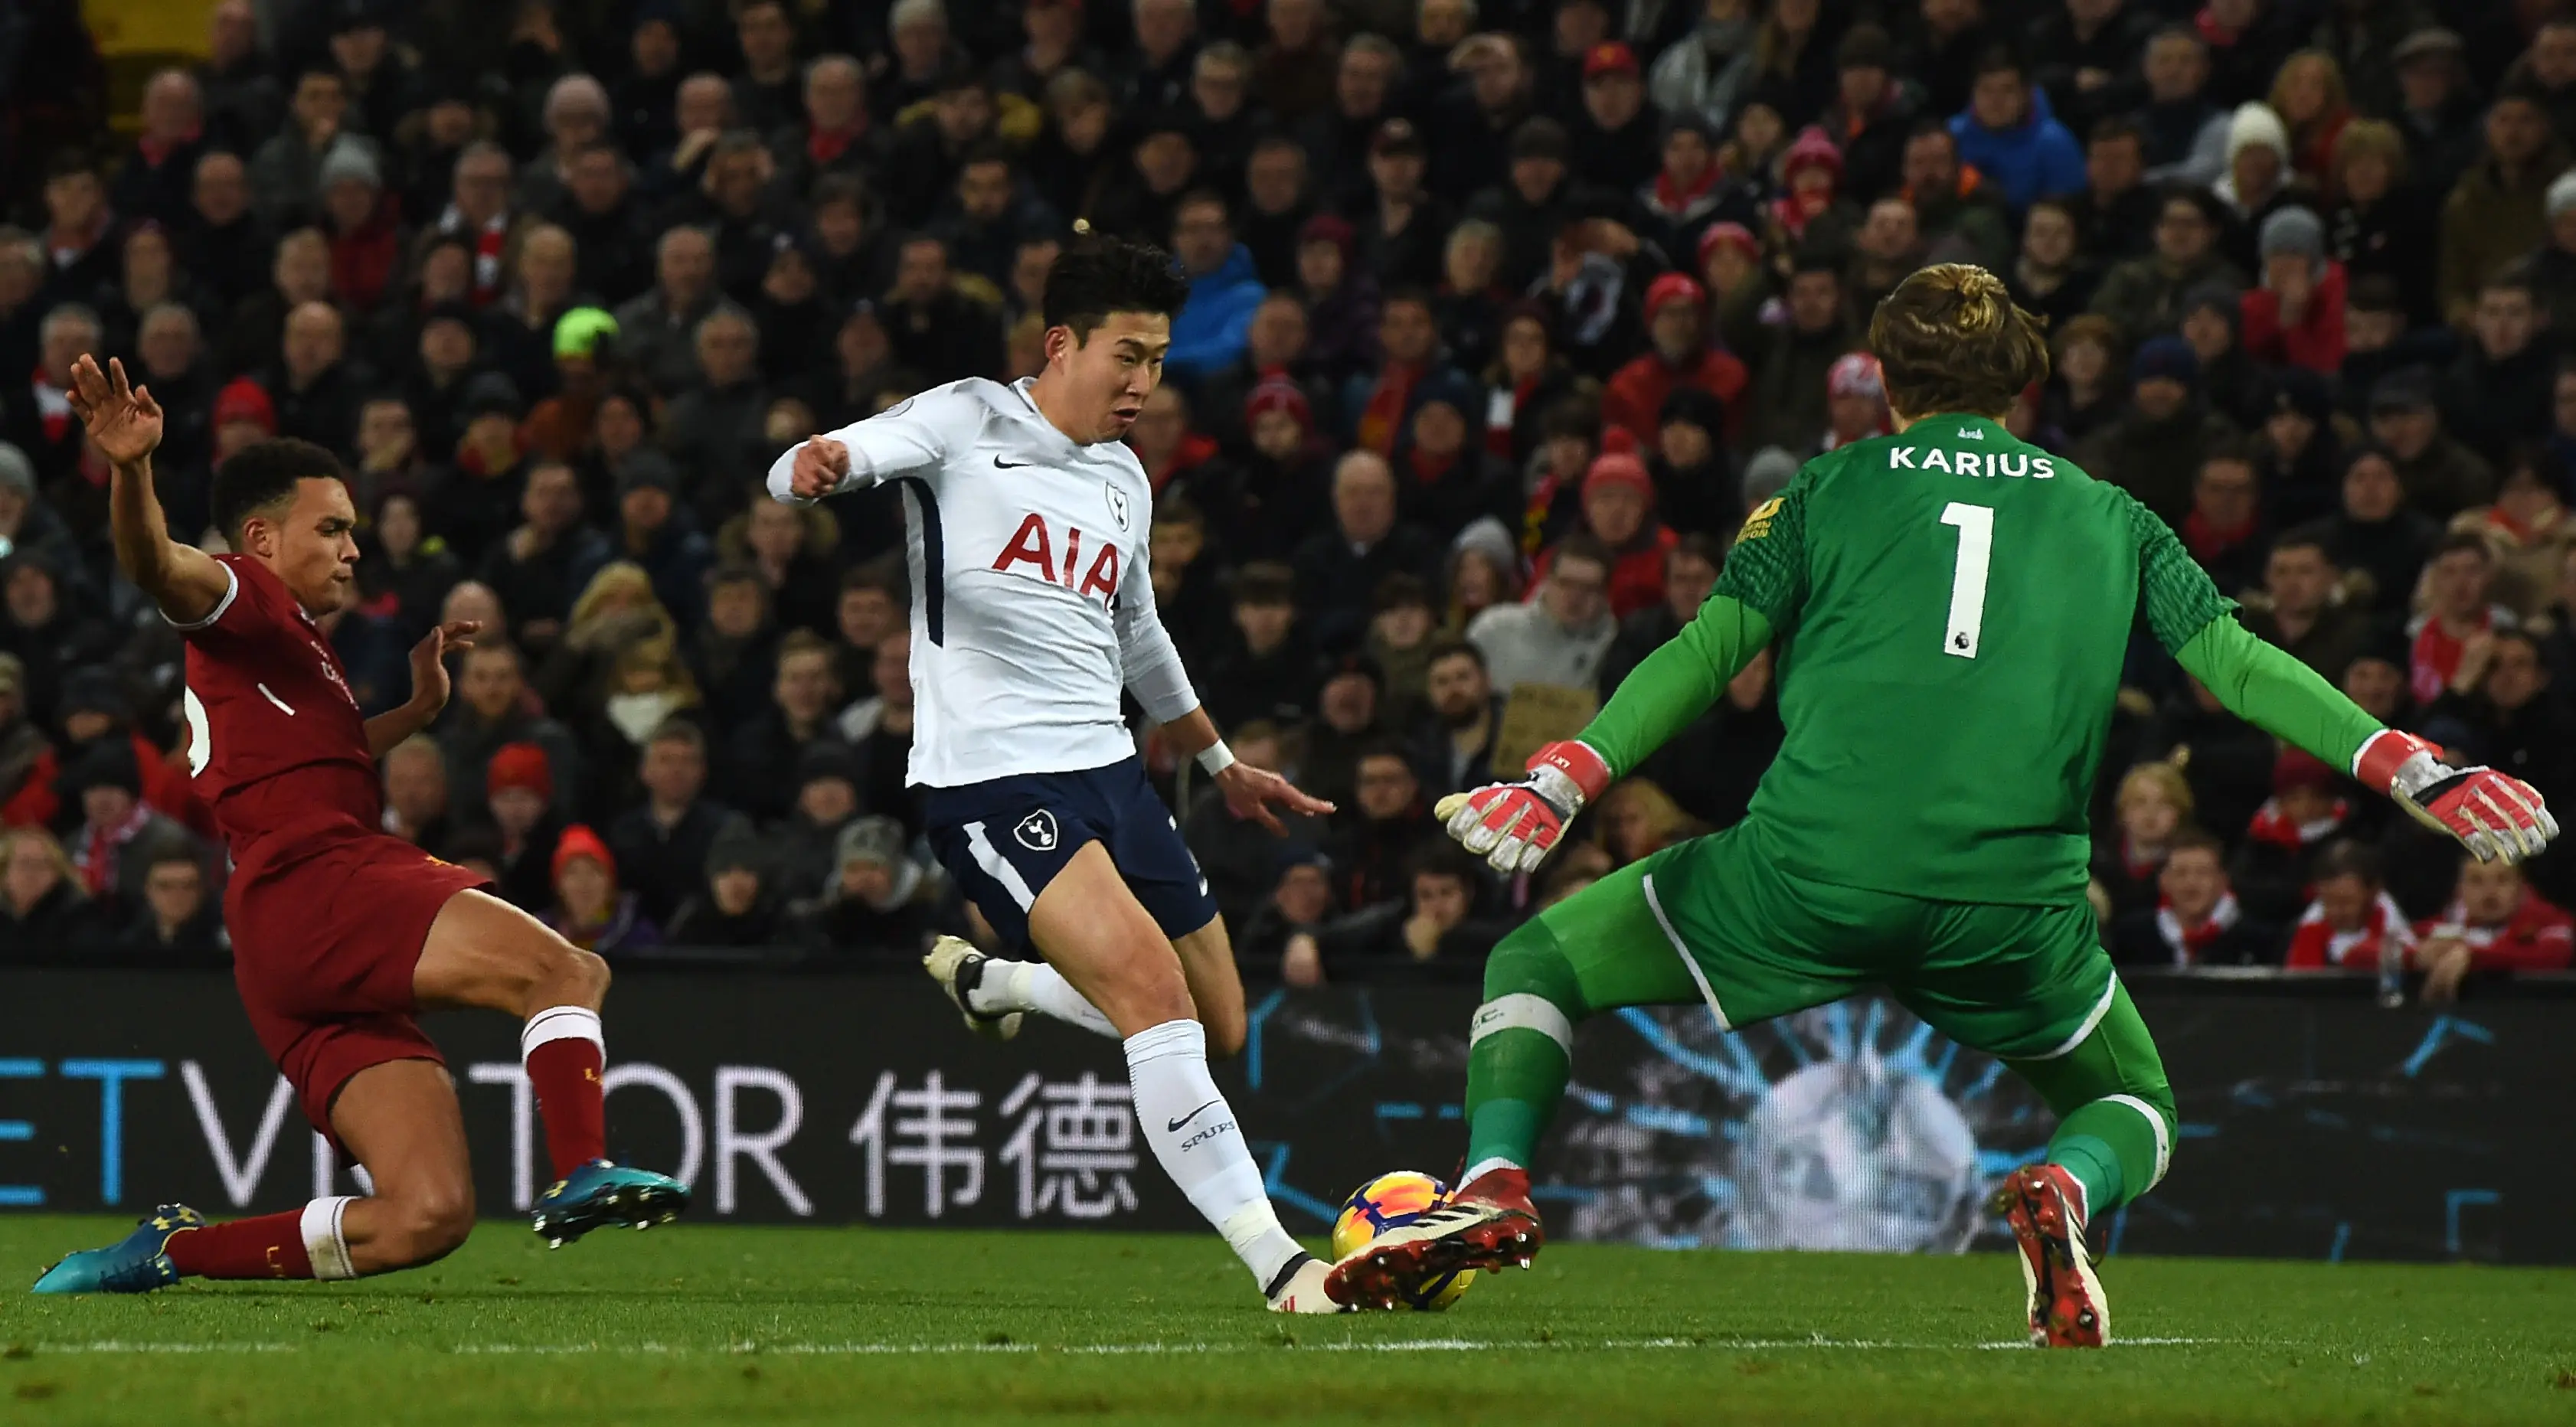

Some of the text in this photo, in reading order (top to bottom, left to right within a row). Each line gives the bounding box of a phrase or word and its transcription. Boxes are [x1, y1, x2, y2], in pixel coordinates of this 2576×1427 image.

[1889, 446, 2055, 478] KARIUS
[992, 513, 1118, 612] AIA
[1940, 501, 1994, 659] 1
[848, 1068, 1139, 1219] 伟德
[1181, 1120, 1235, 1153] SPURS
